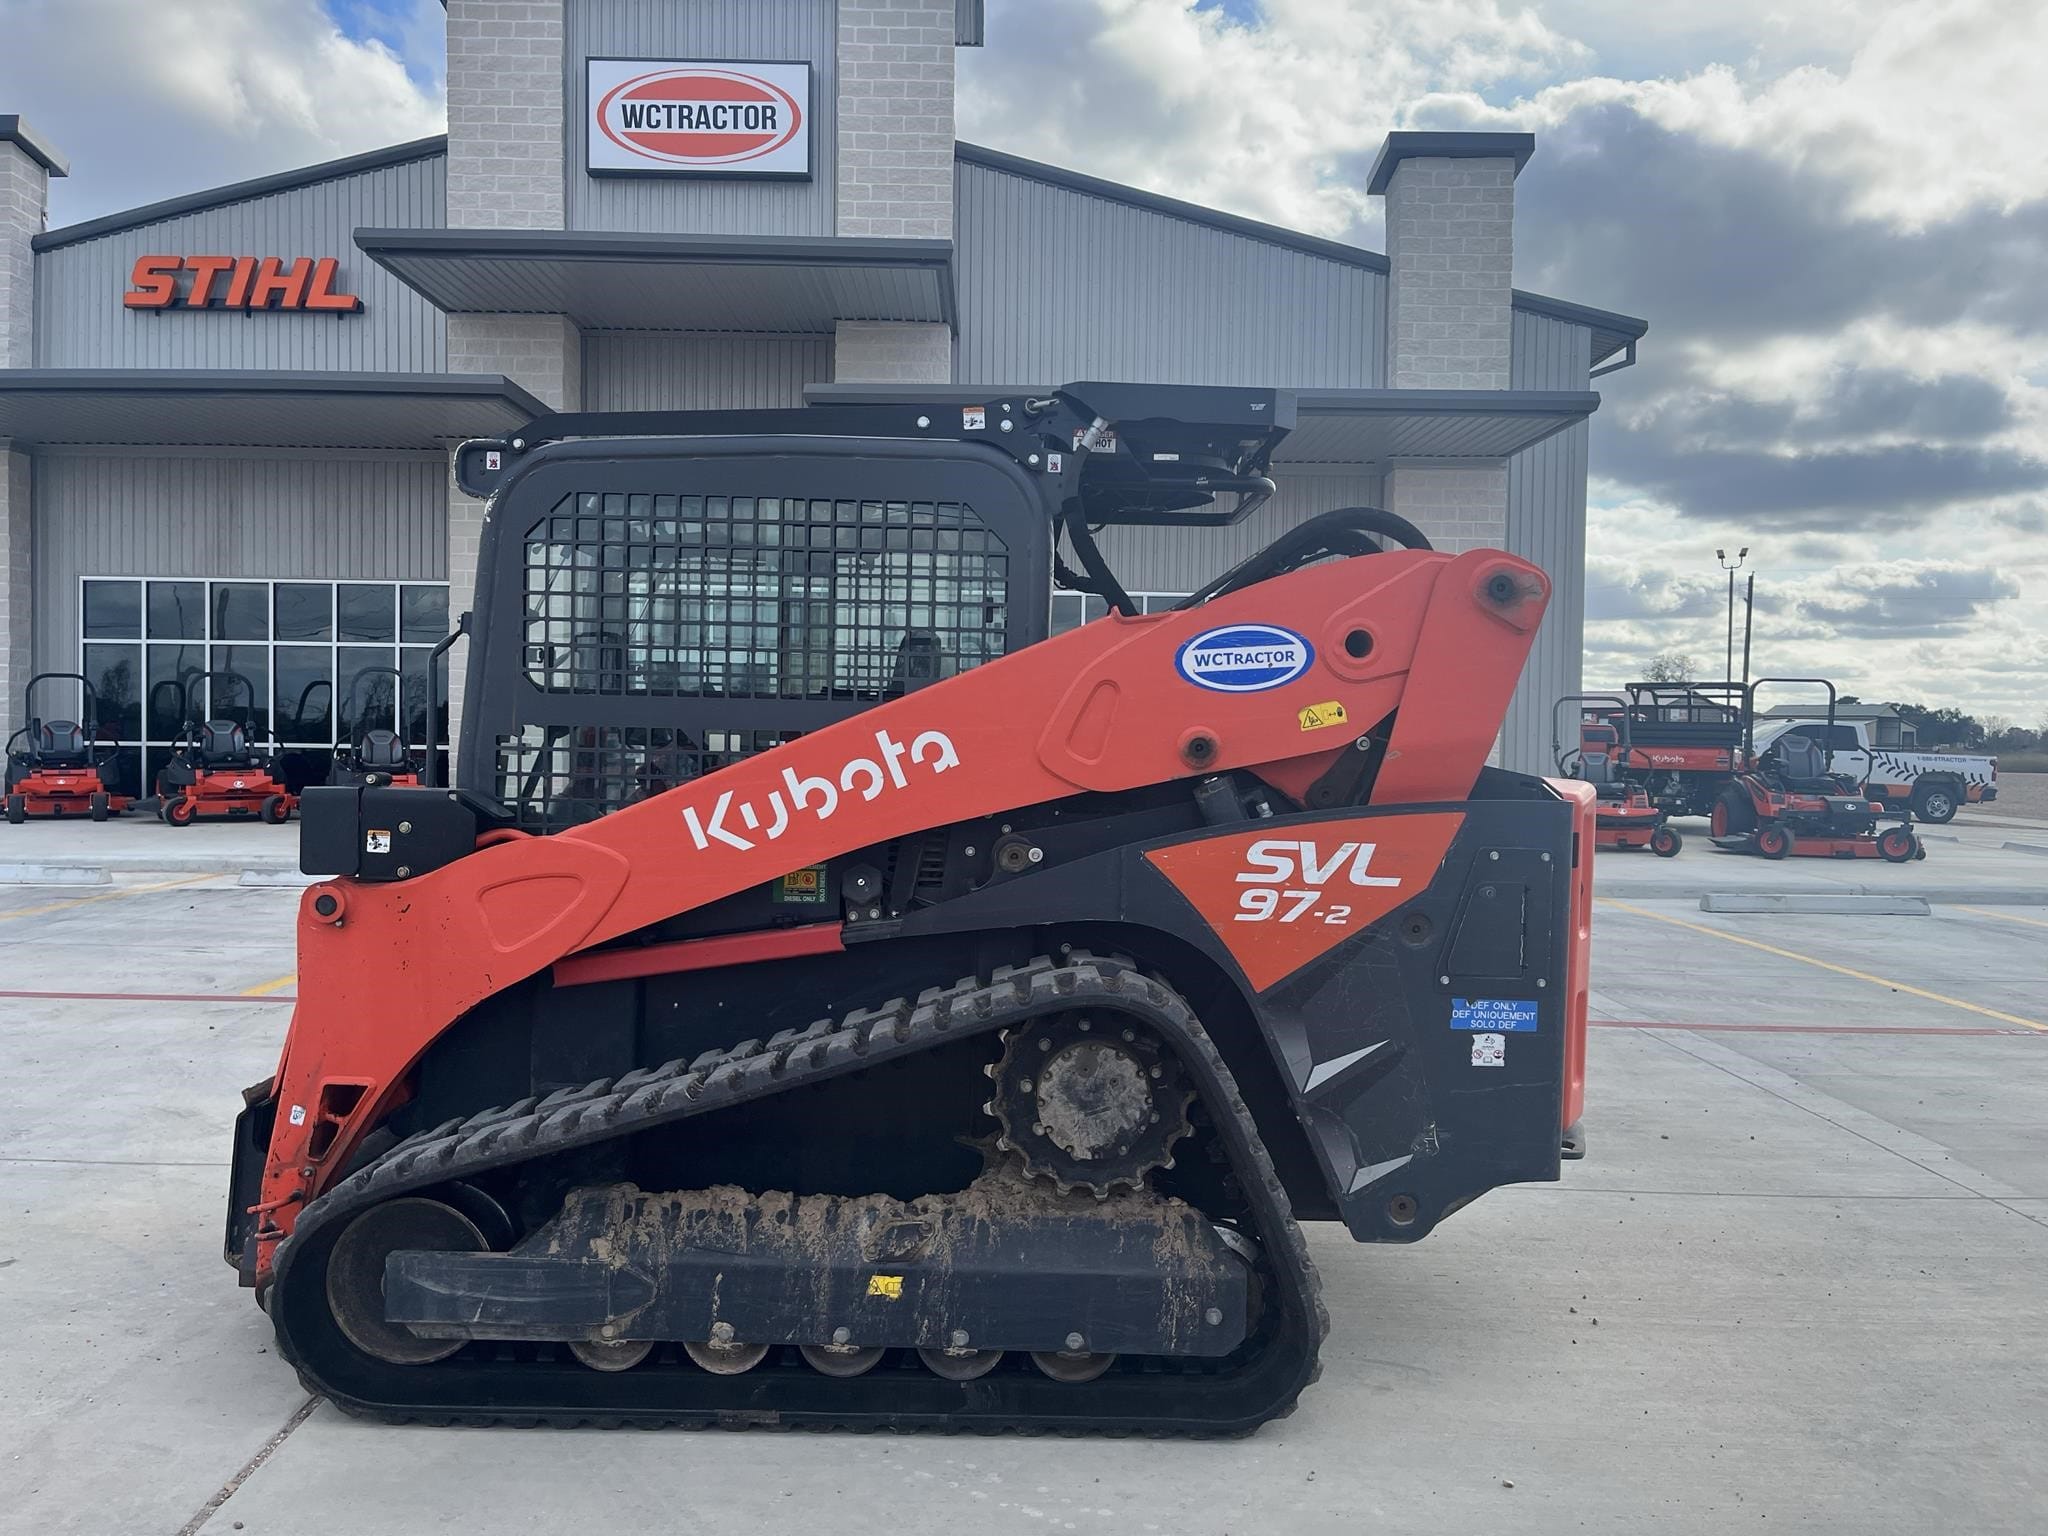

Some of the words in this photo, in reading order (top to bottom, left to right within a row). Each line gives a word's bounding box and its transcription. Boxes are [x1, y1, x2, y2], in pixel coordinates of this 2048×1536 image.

[621, 103, 777, 130] WCTRACTOR
[124, 256, 358, 309] STIHL
[1653, 754, 1685, 763] Kubota
[682, 729, 960, 851] Kubota
[1235, 840, 1401, 887] SVL
[1234, 888, 1351, 924] 97-2
[1452, 1009, 1471, 1018] DEF
[1473, 1010, 1536, 1020] UNIQUEMENT
[1470, 1001, 1489, 1010] DEF
[1493, 1001, 1517, 1011] ONLY
[1470, 1019, 1496, 1029] SOLO
[1498, 1020, 1517, 1029] DEF
